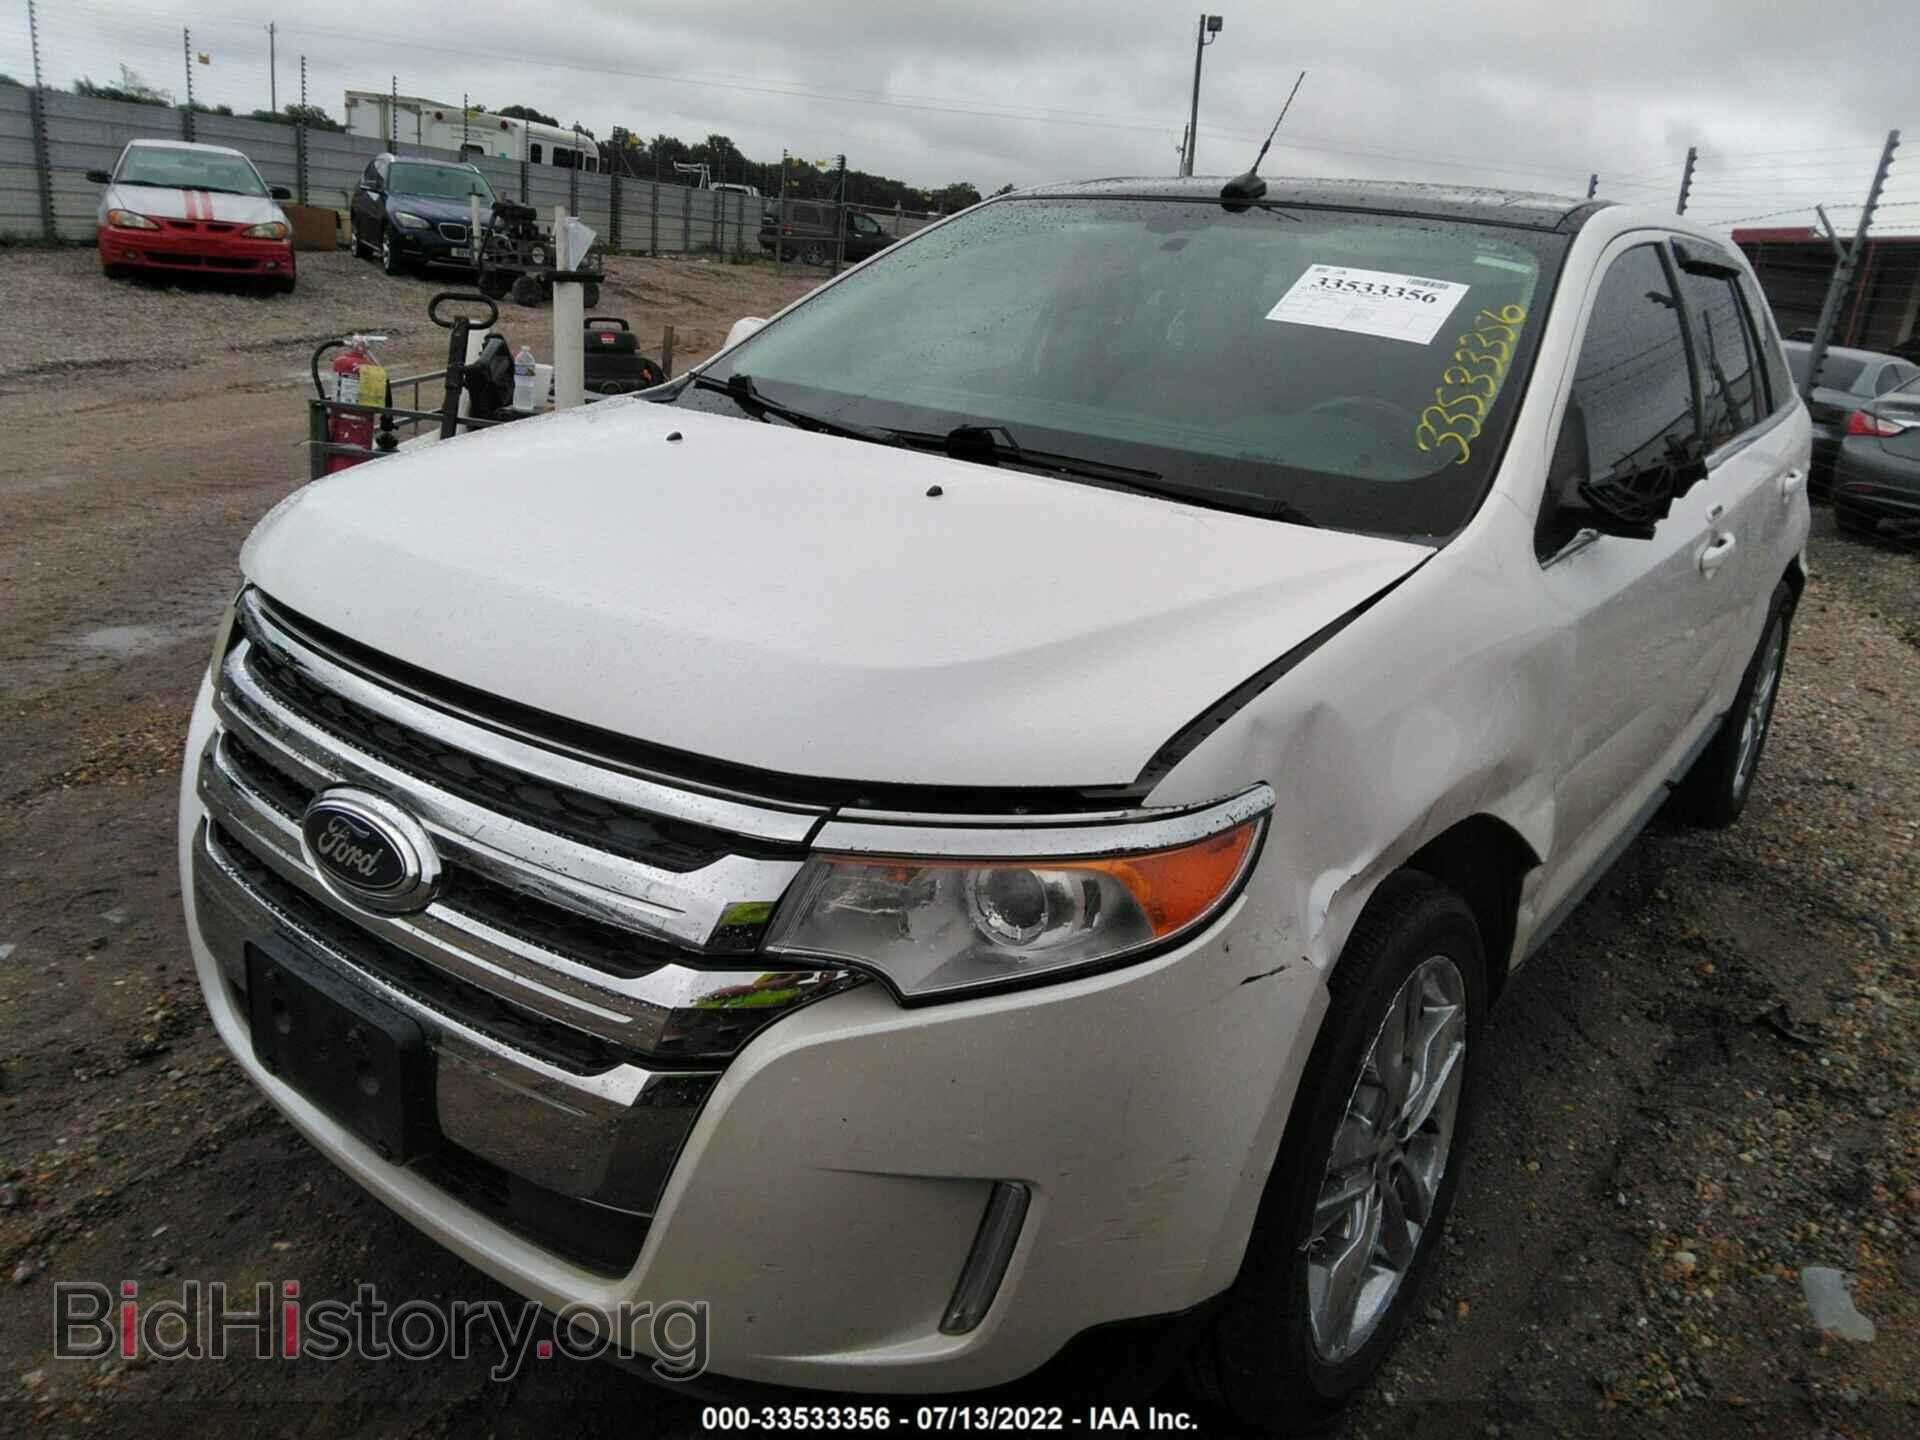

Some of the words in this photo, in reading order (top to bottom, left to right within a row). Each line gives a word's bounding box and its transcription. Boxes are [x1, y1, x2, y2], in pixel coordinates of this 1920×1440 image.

[1311, 276, 1438, 305] 33533356
[1416, 304, 1526, 465] 33533356
[317, 815, 384, 877] Ford
